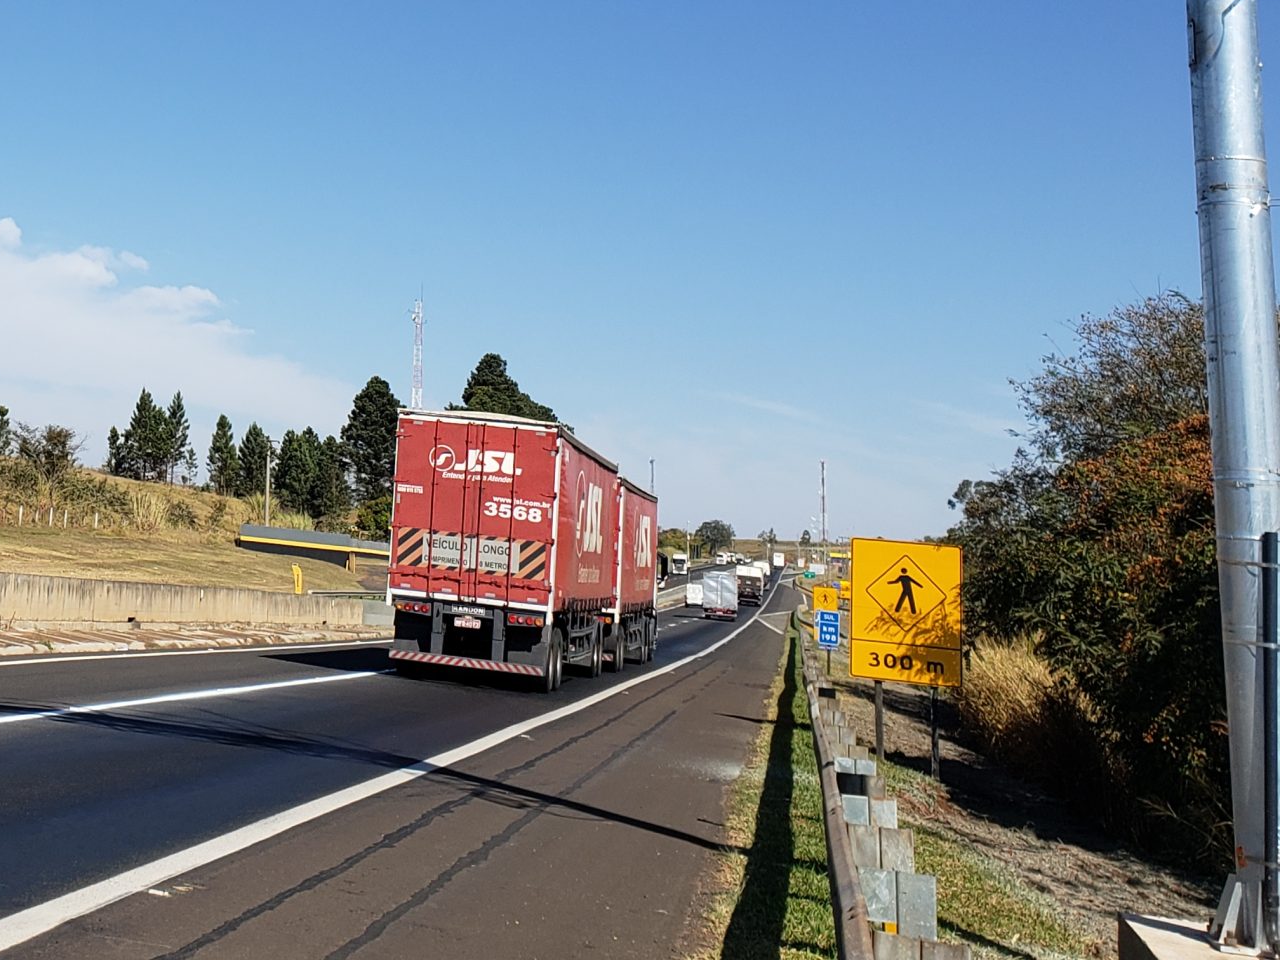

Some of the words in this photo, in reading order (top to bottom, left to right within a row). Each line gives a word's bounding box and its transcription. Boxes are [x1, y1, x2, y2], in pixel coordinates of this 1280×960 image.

[454, 449, 523, 475] JSL
[442, 471, 471, 481] Entendr
[483, 501, 542, 523] 3568
[583, 482, 603, 554] JSL
[423, 554, 468, 566] CMPRIMENO
[823, 613, 836, 621] SUL
[868, 652, 914, 671] 300
[926, 661, 945, 675] m
